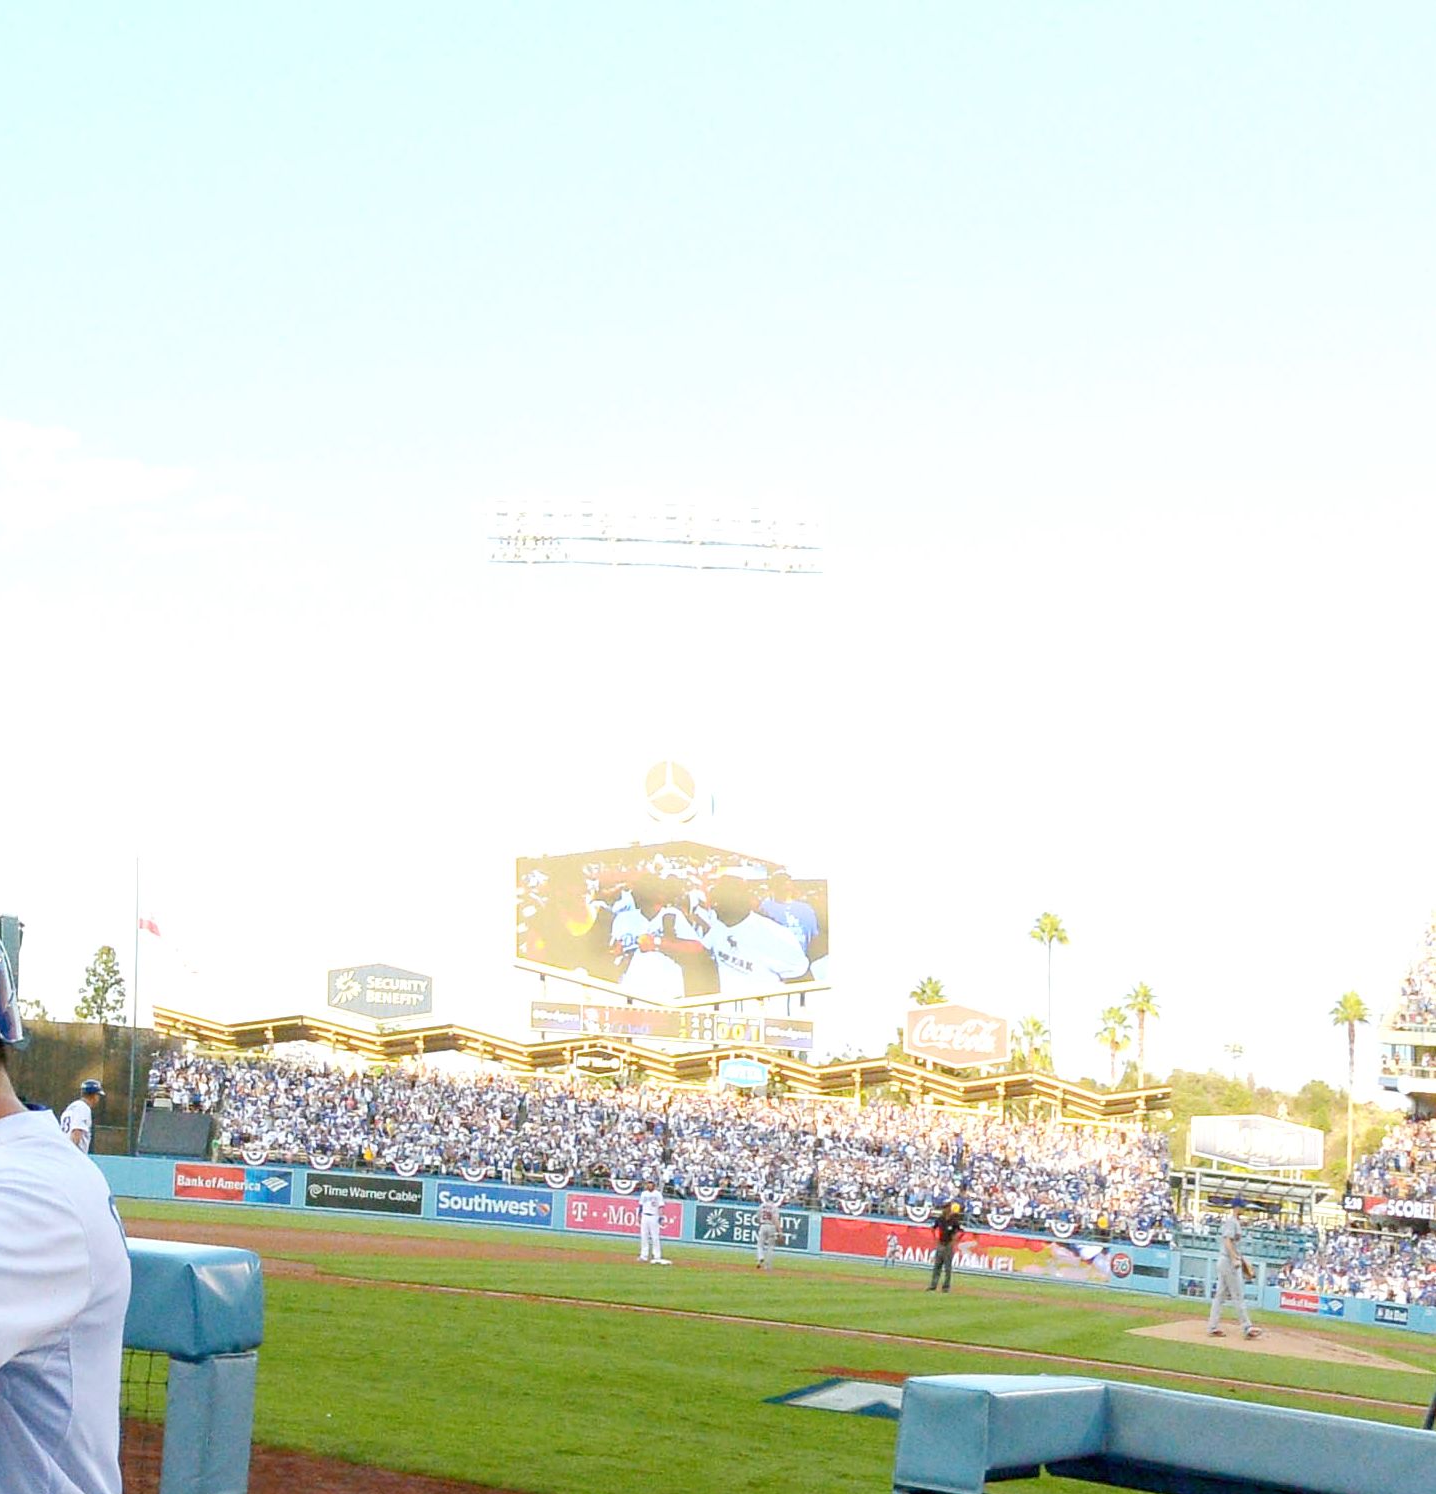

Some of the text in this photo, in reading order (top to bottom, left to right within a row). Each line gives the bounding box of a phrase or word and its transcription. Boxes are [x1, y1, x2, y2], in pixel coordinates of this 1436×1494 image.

[366, 975, 427, 992] SECURITY
[366, 989, 424, 1006] BENEFIT
[177, 1174, 261, 1192] Bank of America
[322, 1183, 418, 1201] Time Warner Cable
[438, 1191, 537, 1217] Southwest
[1386, 1199, 1436, 1219] SCORE!
